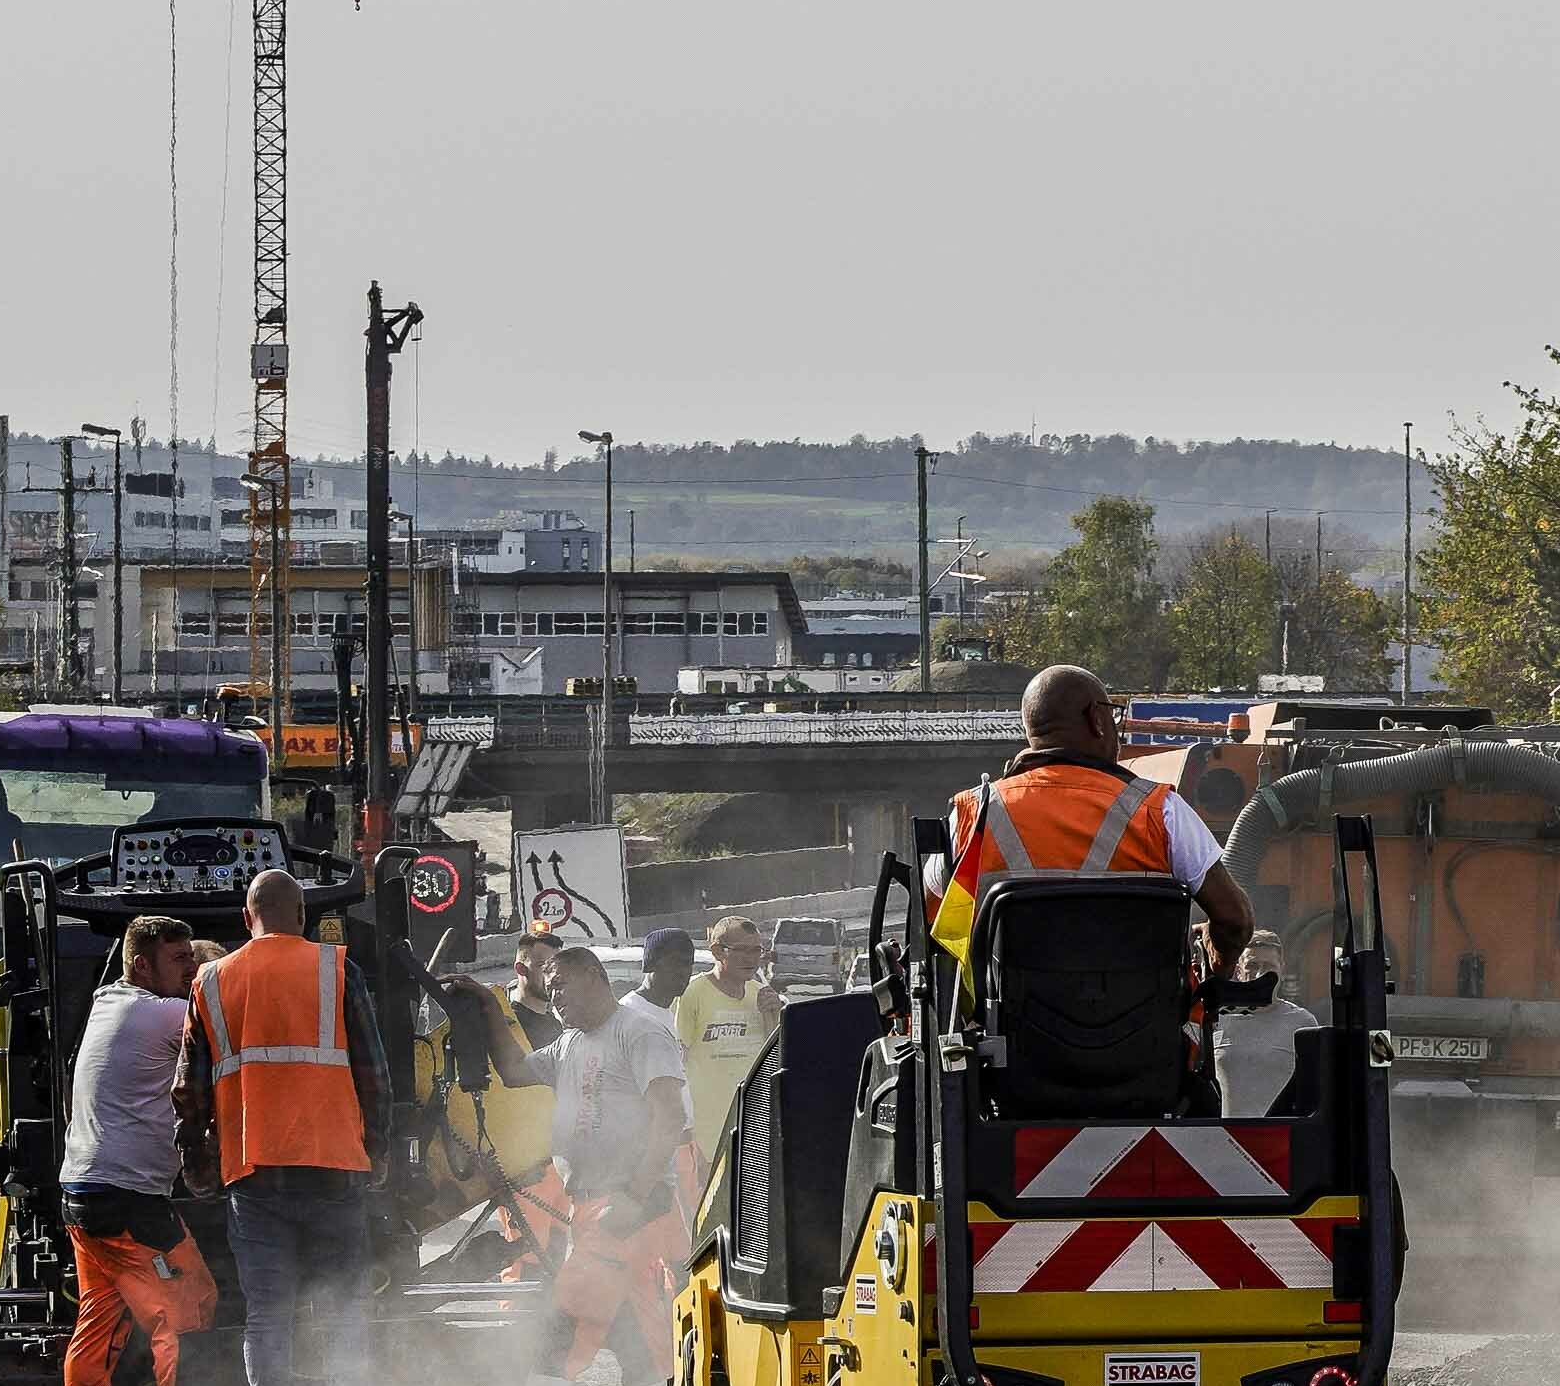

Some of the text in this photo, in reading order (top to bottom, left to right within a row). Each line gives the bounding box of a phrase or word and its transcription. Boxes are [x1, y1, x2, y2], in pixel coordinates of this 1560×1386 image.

[1400, 1038, 1481, 1057] PF K 250
[1108, 1364, 1197, 1381] STRABAG
